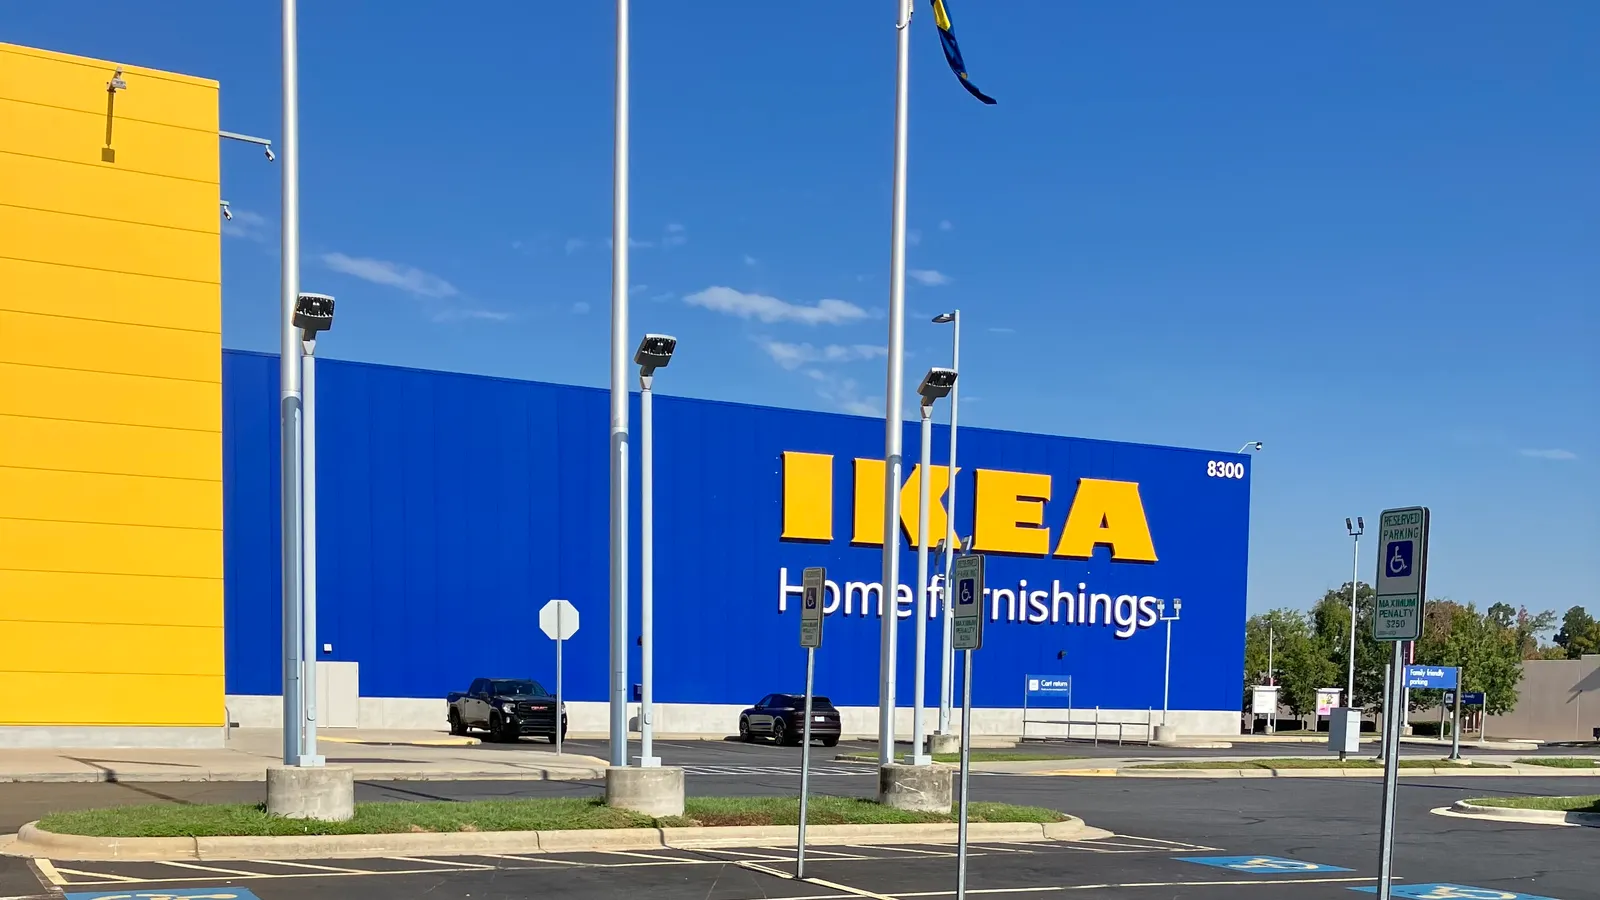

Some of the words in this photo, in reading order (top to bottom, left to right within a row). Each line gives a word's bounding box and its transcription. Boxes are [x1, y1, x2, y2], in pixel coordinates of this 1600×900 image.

[1207, 460, 1244, 479] 8300
[781, 451, 1159, 562] IKEA
[1384, 512, 1419, 526] RESERVED
[1384, 527, 1419, 540] PARKING
[927, 574, 1157, 638] fnishings
[1379, 598, 1416, 608] MAXIMUM
[1379, 608, 1414, 618] PENALTY
[1386, 619, 1406, 628] $250
[1410, 669, 1426, 677] Family
[1427, 668, 1445, 678] friendly
[1409, 678, 1428, 687] parking
